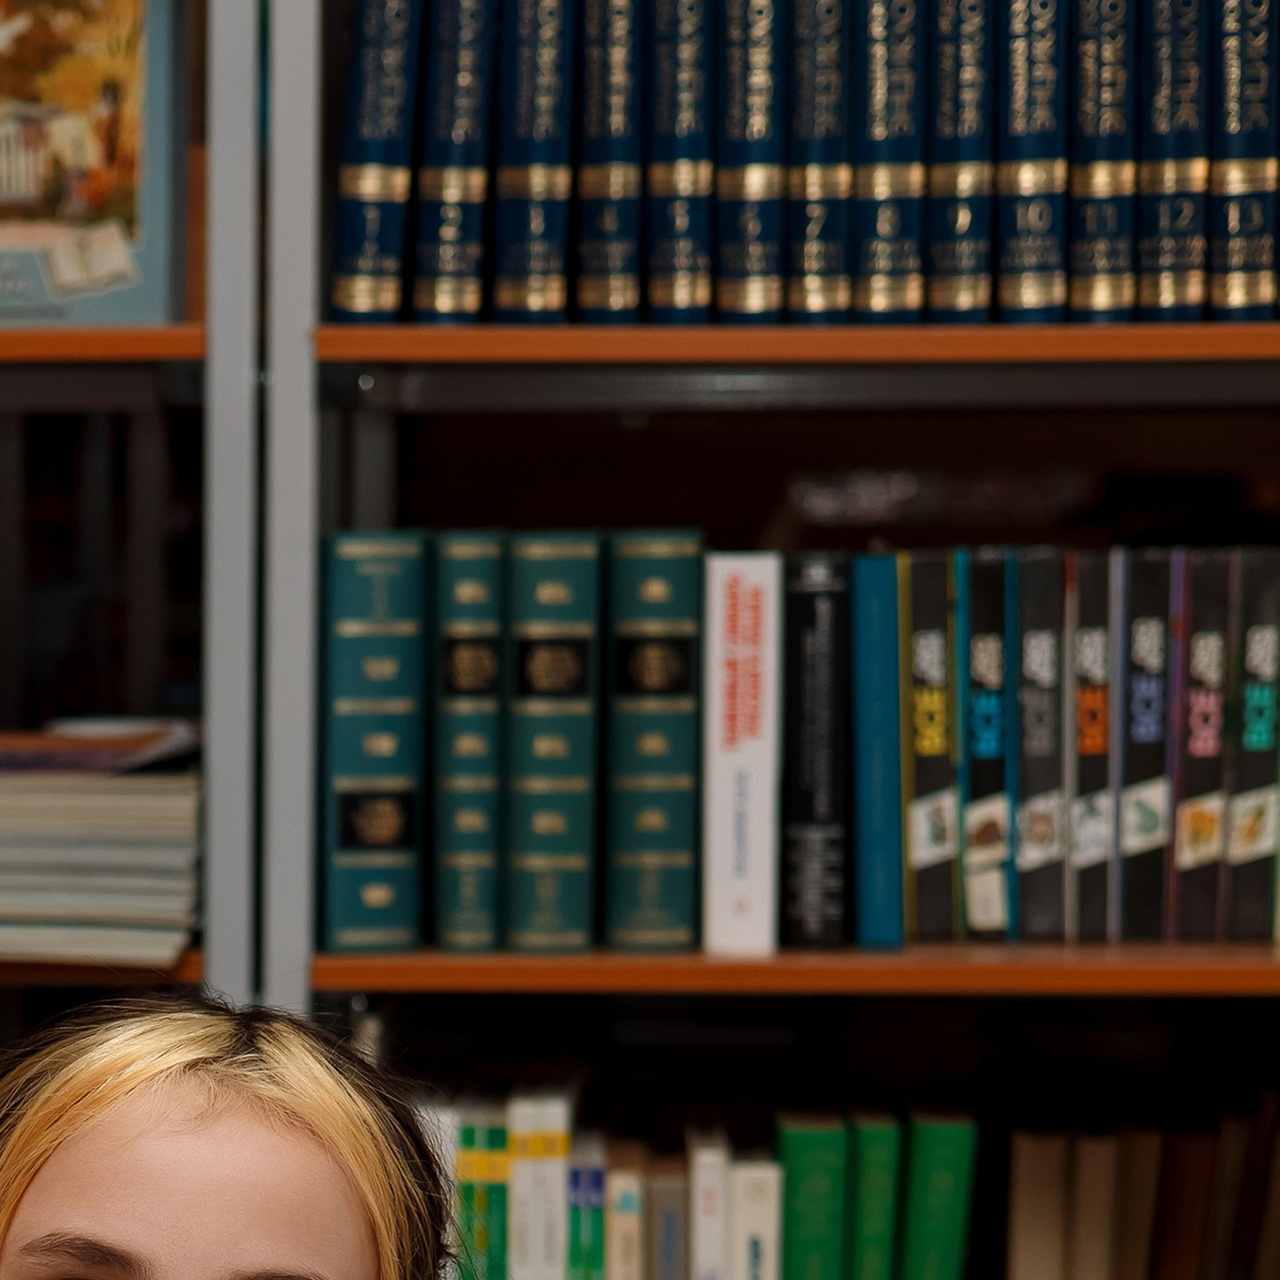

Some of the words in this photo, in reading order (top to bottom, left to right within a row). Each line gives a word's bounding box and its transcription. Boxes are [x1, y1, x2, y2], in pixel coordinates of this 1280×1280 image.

[440, 203, 463, 241] 2
[806, 202, 827, 239] 7
[876, 202, 901, 238] 8
[1016, 199, 1053, 235] 10
[1080, 202, 1118, 235] 11
[1158, 199, 1195, 235] 12
